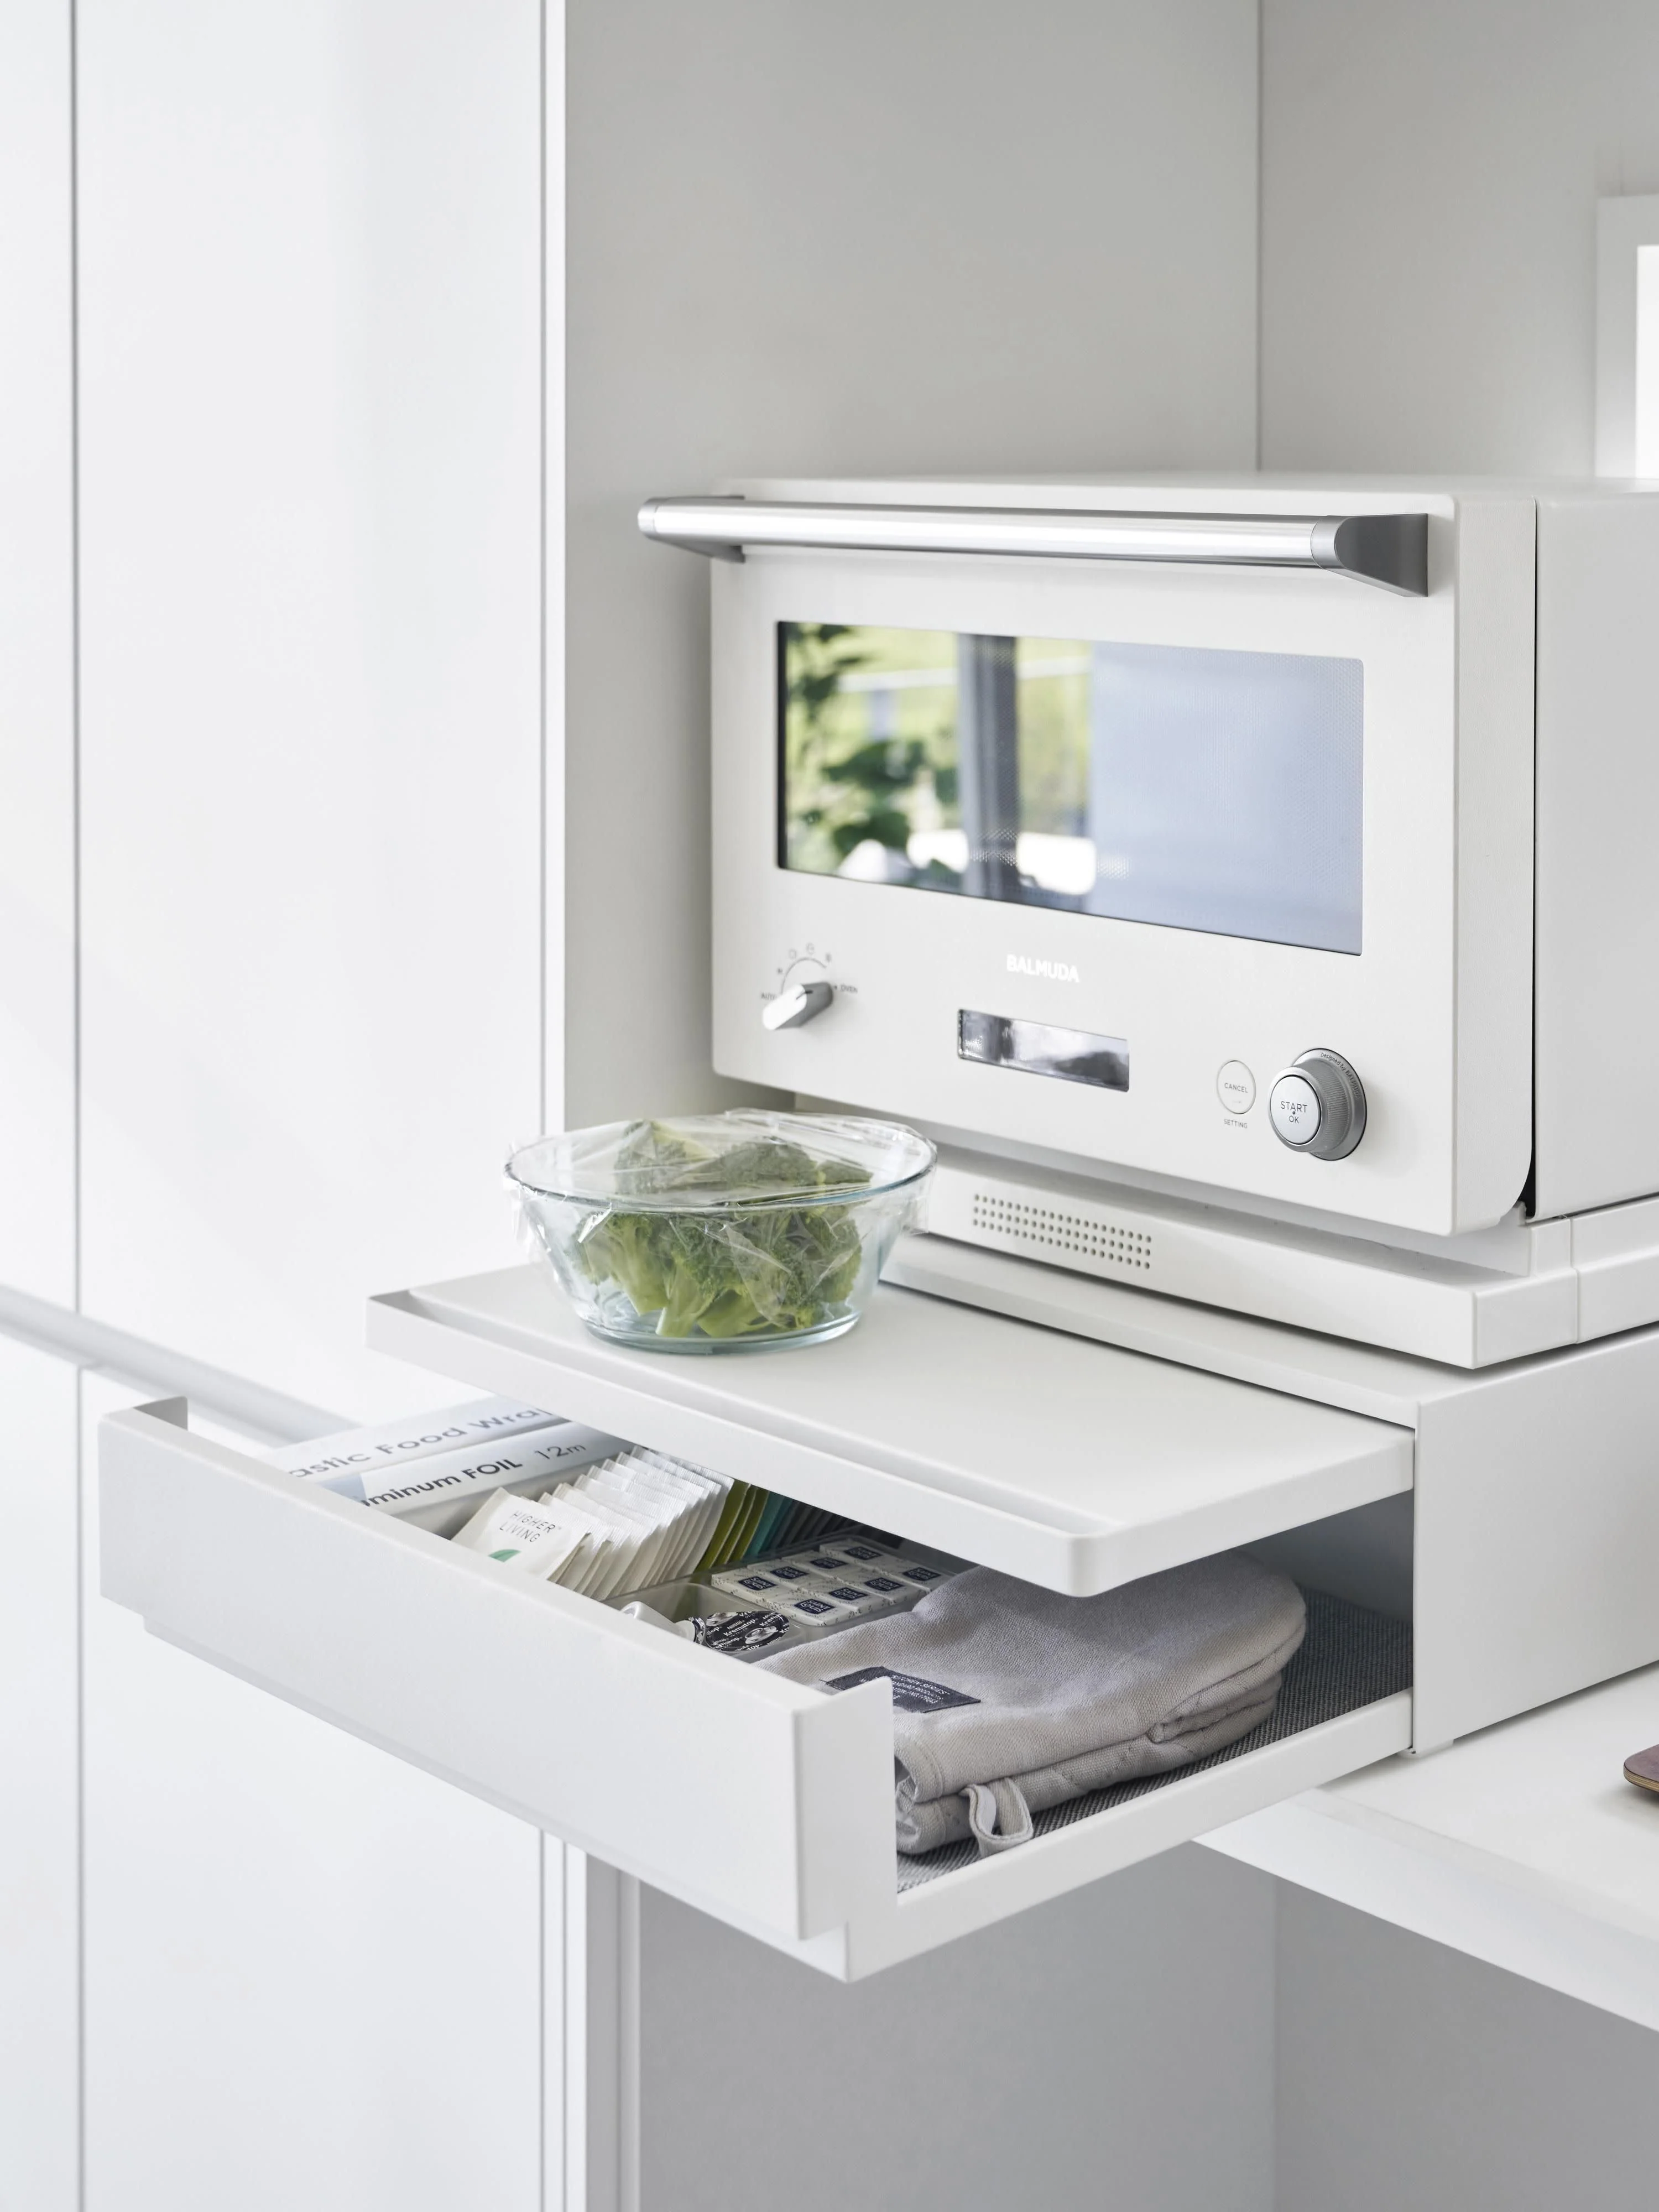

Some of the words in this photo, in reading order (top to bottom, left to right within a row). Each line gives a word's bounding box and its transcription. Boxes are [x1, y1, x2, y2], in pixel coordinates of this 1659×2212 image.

[1006, 953, 1080, 983] BALMUDA
[1321, 1053, 1341, 1065] Designed
[1224, 1083, 1248, 1093] CANCEL
[1281, 1100, 1308, 1113] START
[1224, 1119, 1248, 1129] SETTING
[1288, 1115, 1299, 1124] OK
[375, 1427, 467, 1454] Food
[468, 1408, 552, 1429] Wra
[462, 1459, 523, 1479] FOIL
[534, 1444, 586, 1459] 12m
[510, 1510, 556, 1533] HIGHER
[499, 1522, 540, 1542] LIVING
[796, 1601, 825, 1613] LOUIS
[805, 1599, 832, 1610] SAINT
[723, 1618, 756, 1636] Krematop
